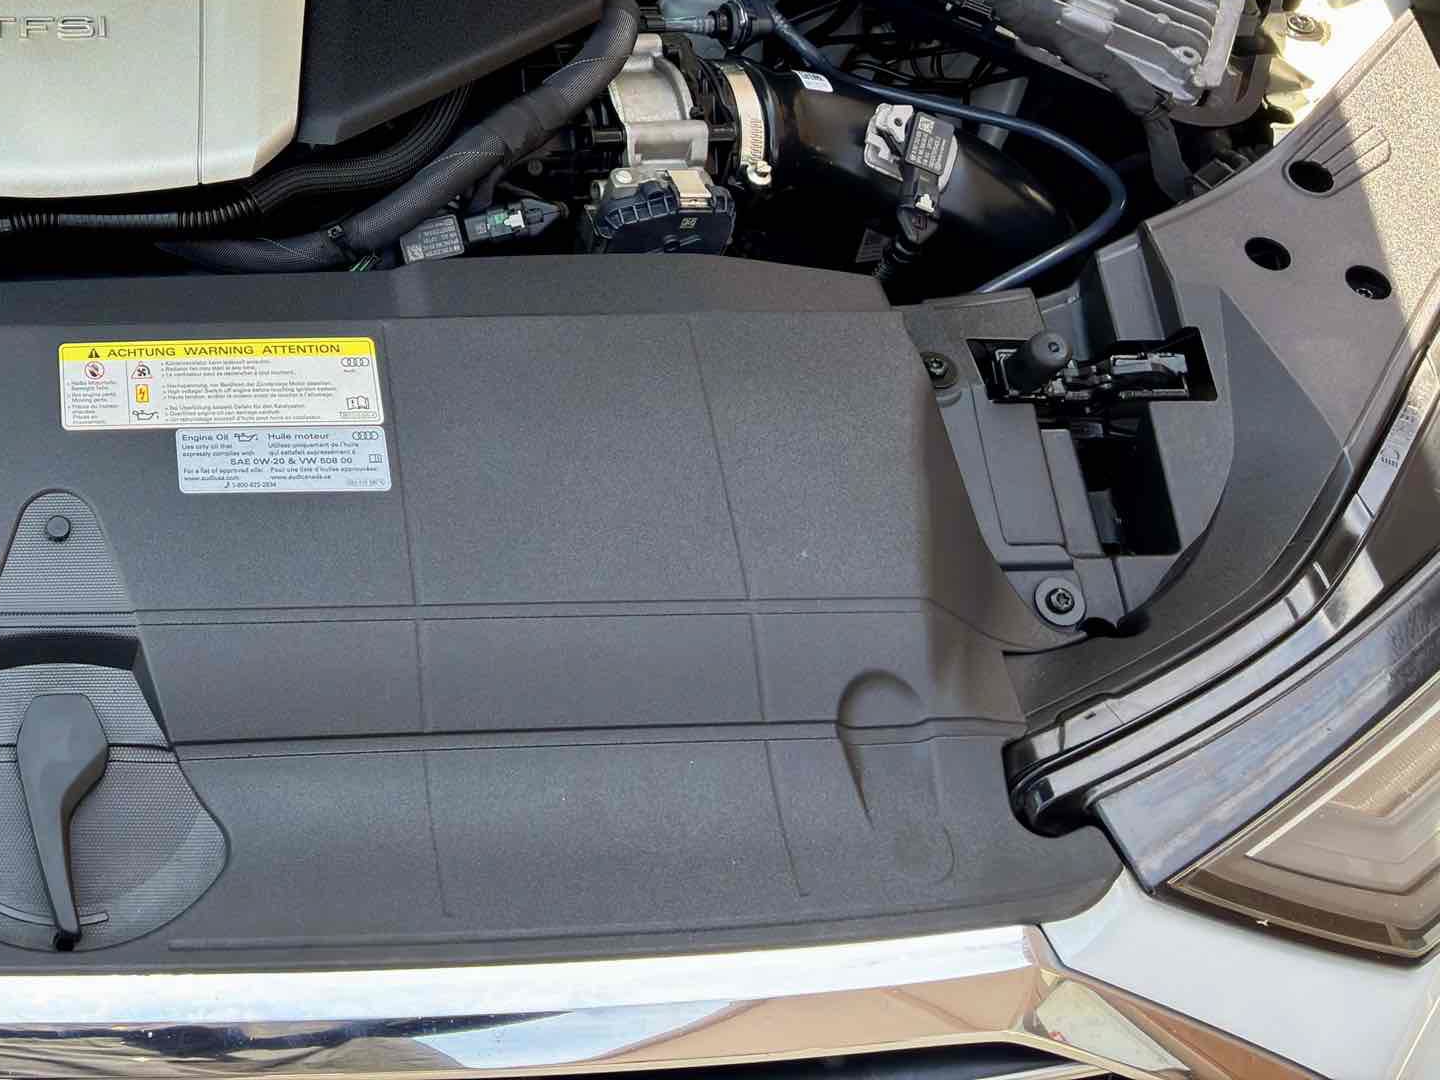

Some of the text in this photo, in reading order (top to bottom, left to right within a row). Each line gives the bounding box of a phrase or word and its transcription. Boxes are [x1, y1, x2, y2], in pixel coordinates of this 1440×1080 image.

[107, 343, 340, 358] ACHTUNG WARNING ATTENTION
[182, 433, 213, 442] Engine
[268, 431, 291, 439] Huile
[253, 457, 285, 465] 0W-20
